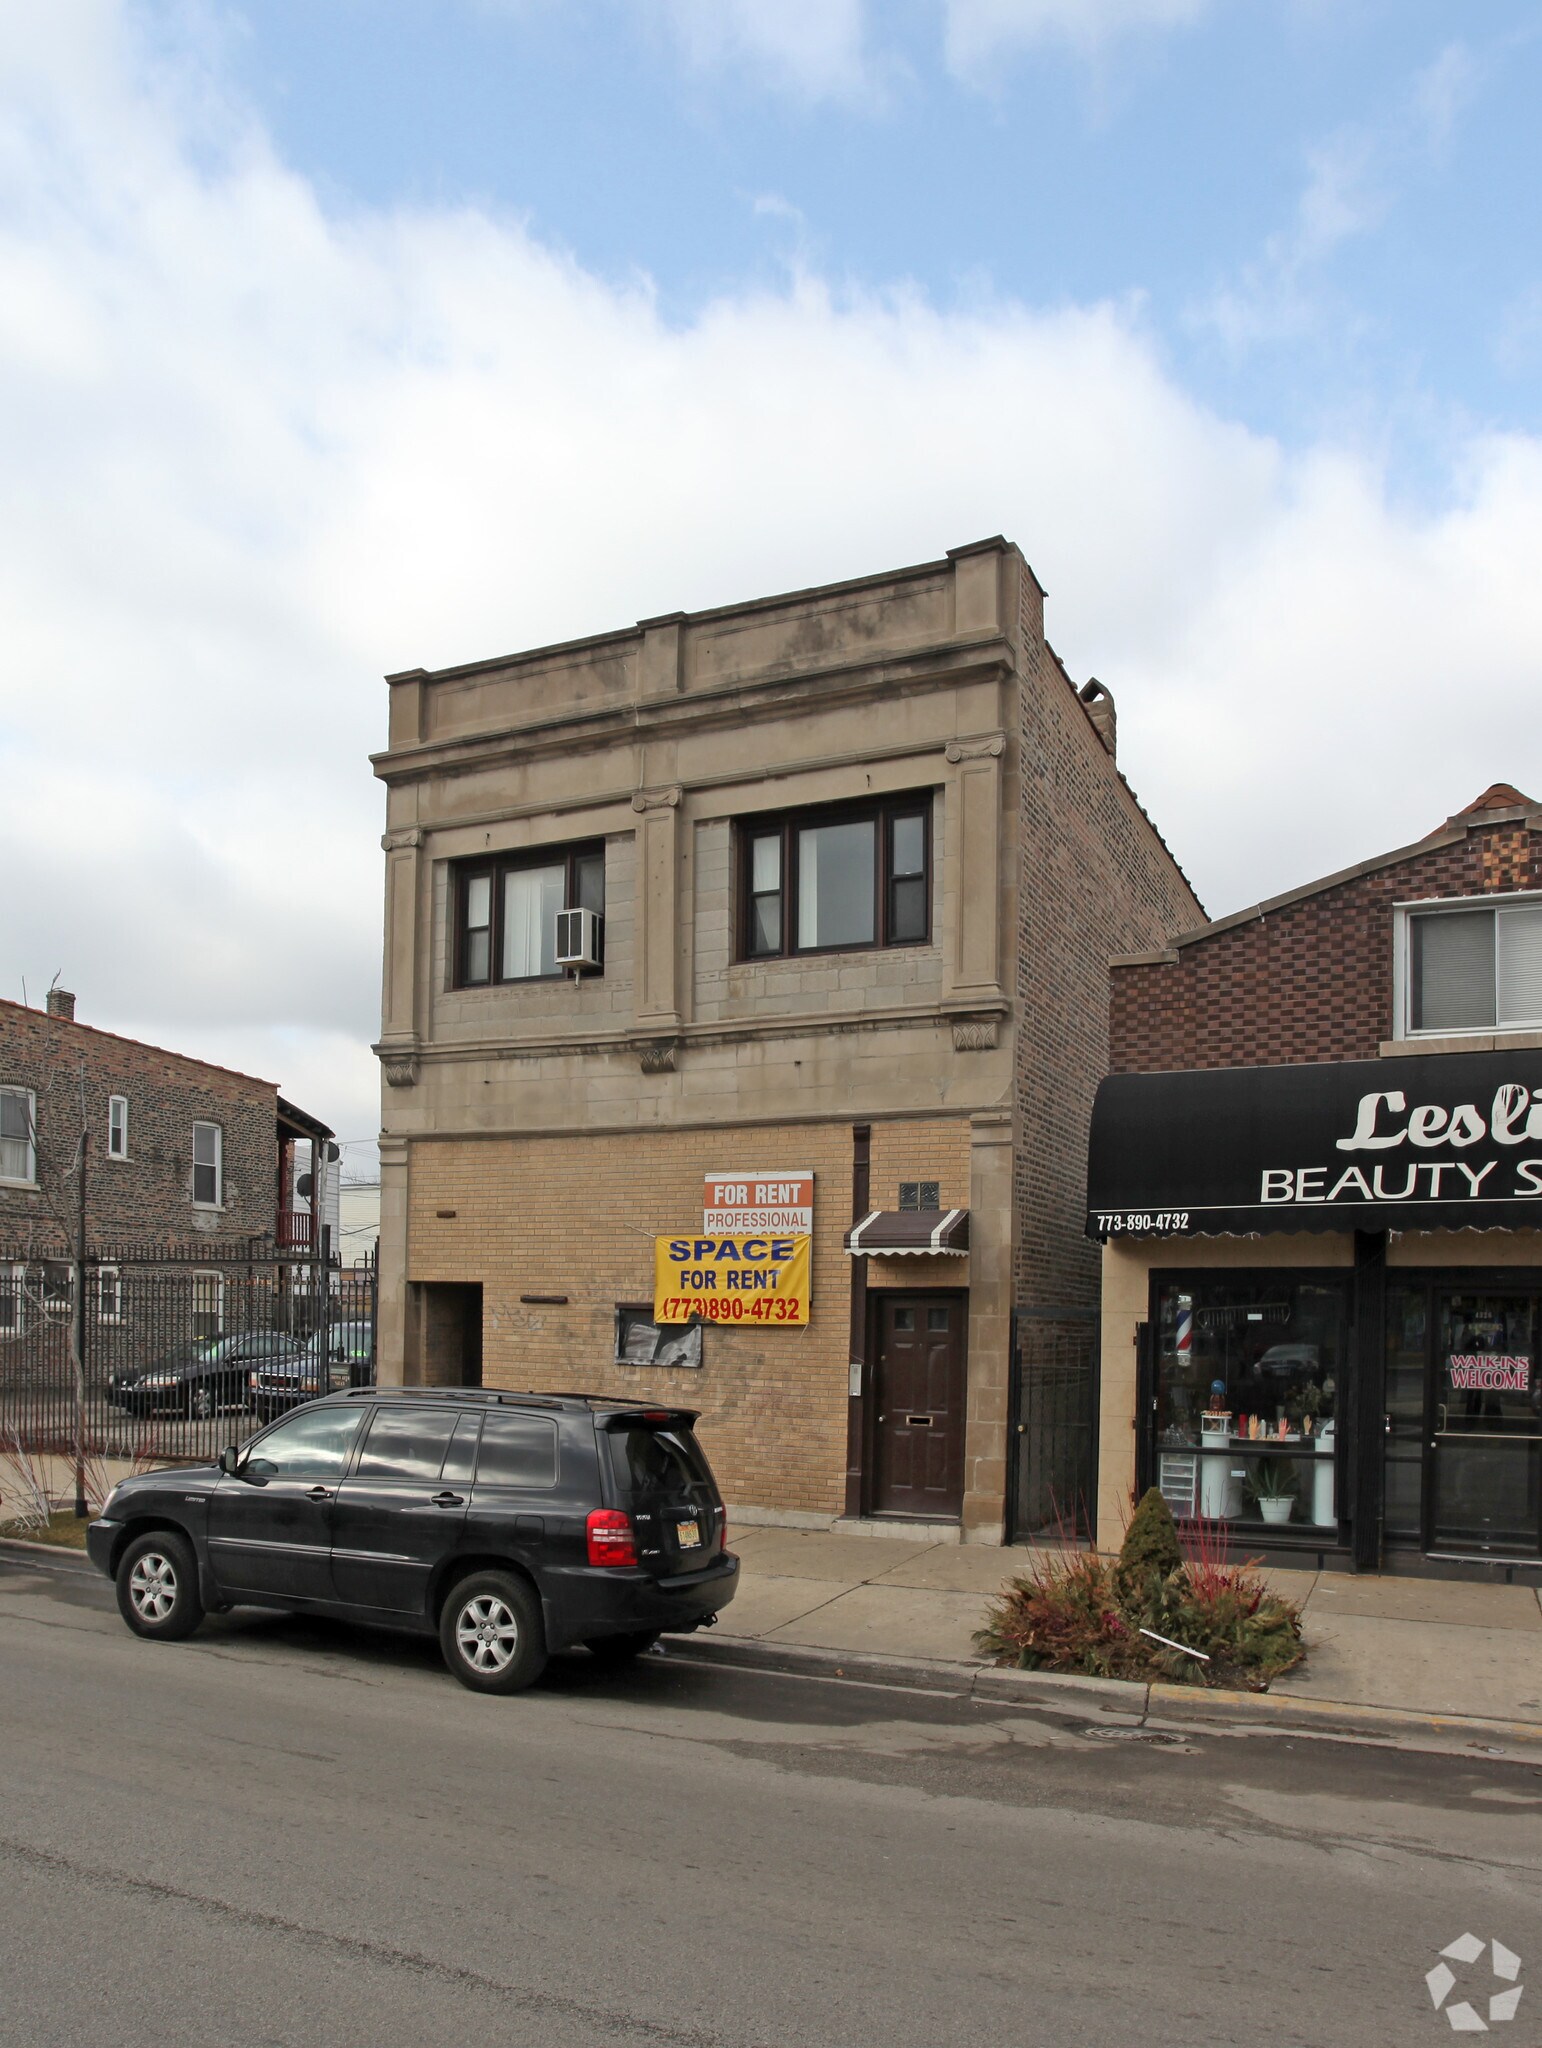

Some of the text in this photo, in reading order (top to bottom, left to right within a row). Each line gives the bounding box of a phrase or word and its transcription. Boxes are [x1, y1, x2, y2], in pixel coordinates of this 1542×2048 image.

[1261, 1160, 1498, 1203] BEAUTY
[714, 1183, 801, 1205] FOR RENT
[707, 1212, 808, 1228] PROFESSIONAL
[1097, 1212, 1189, 1231] 773-890-4732
[669, 1239, 795, 1262] SPACE
[680, 1269, 781, 1290] FOR RENT
[663, 1297, 800, 1320] (773)890-4732
[1450, 1354, 1529, 1370] WALK-INS
[1450, 1368, 1528, 1391] WELCOME
